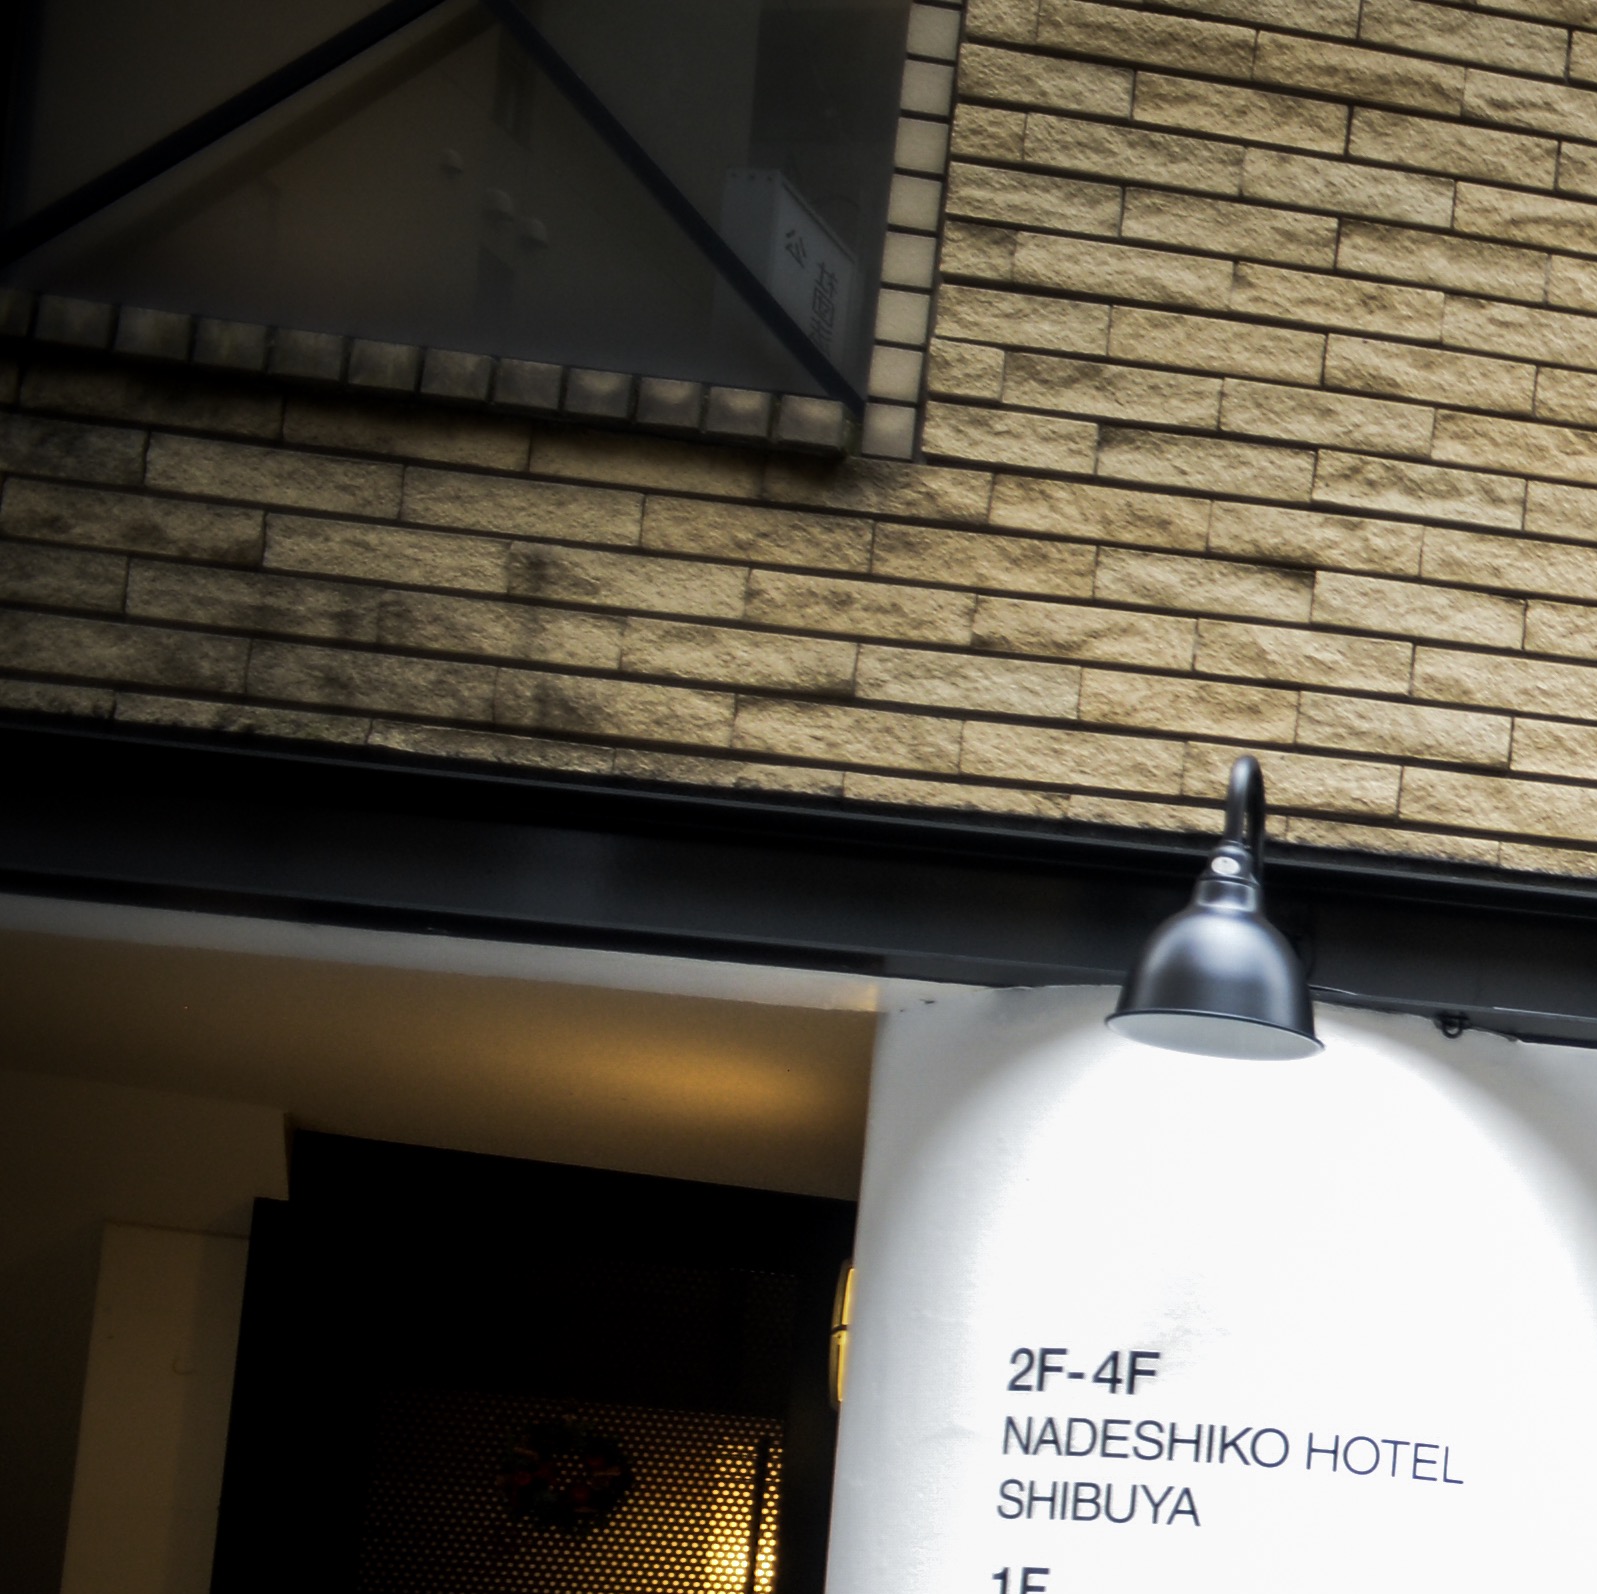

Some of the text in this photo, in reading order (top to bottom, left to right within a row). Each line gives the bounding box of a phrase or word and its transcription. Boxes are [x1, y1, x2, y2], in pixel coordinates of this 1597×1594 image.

[1007, 1347, 1162, 1396] 2F-4F
[1002, 1415, 1464, 1485] NADESHIKO HOTEL
[996, 1479, 1202, 1527] SHIBUYA
